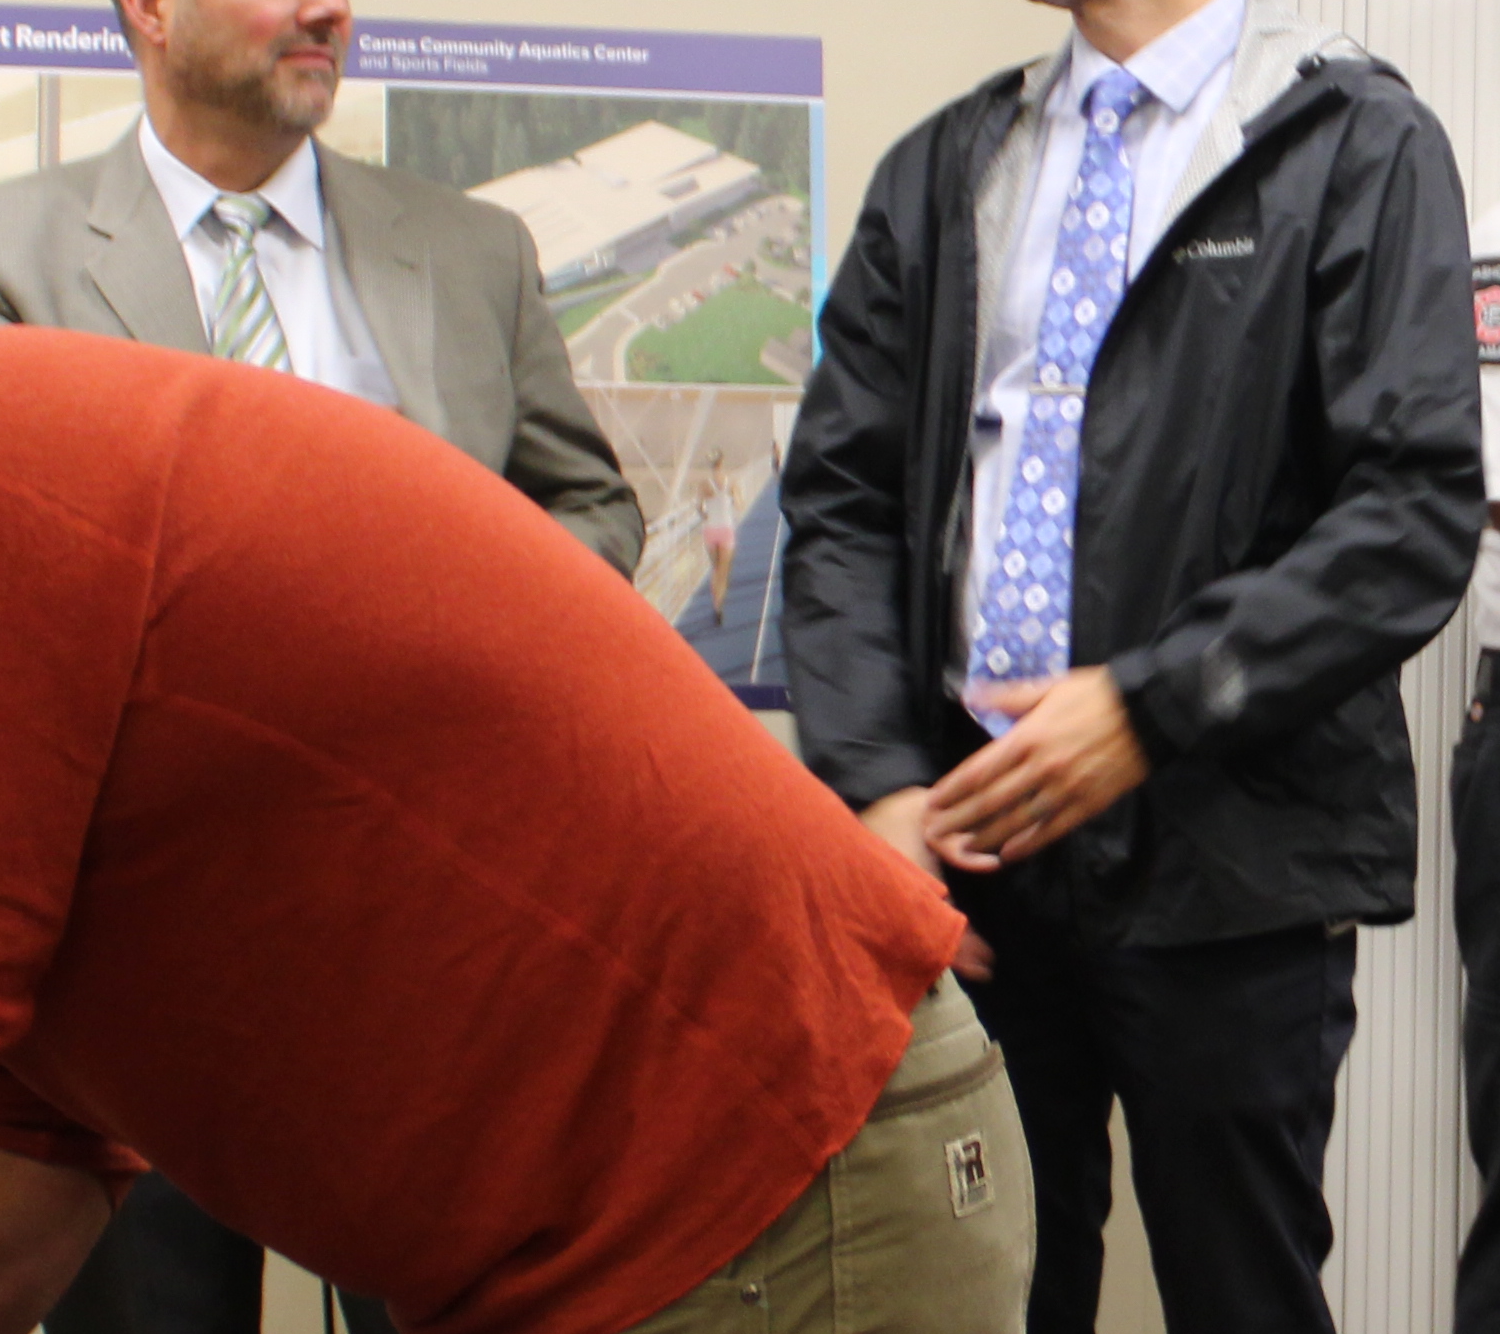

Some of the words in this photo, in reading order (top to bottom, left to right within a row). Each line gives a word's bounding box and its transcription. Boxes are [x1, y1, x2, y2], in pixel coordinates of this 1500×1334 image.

[15, 23, 134, 60] Renderin
[359, 33, 416, 52] Camas
[420, 36, 516, 60] Community
[519, 40, 591, 61] Aquatics
[594, 44, 650, 63] Center
[359, 53, 388, 69] and
[391, 54, 440, 73] Sports
[443, 56, 489, 74] Fields
